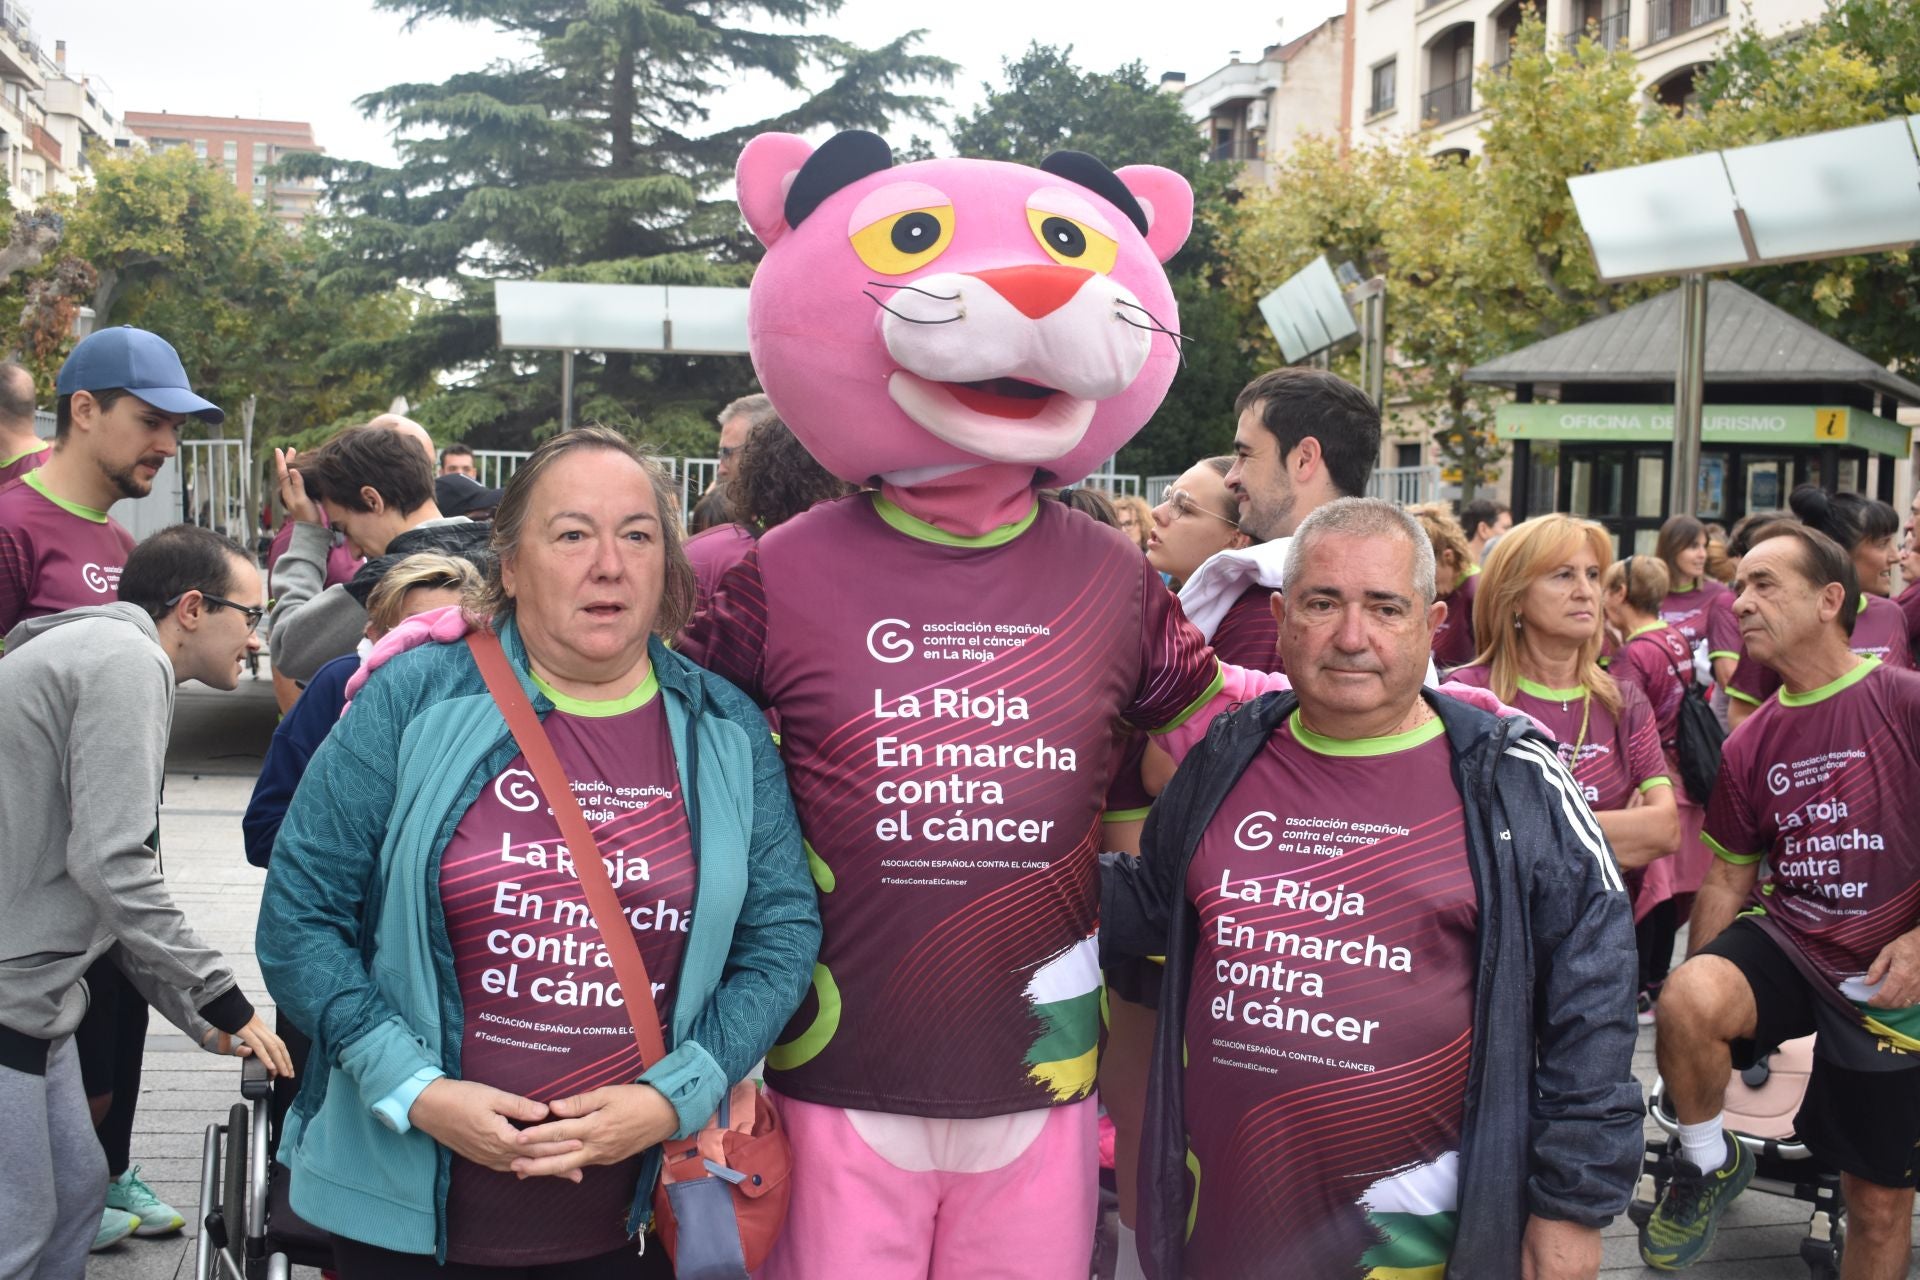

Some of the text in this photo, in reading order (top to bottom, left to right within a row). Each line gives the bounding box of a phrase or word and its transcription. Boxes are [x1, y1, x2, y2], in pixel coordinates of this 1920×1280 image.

[1560, 414, 1787, 432] OFICINA DE URISMO
[922, 621, 1050, 636] asociación española
[922, 635, 1026, 647] contra el cáncer
[923, 649, 995, 662] en La Rioja
[874, 688, 1029, 726] La Rioja
[876, 736, 1077, 772] En marcha
[1791, 750, 1866, 769] asociació española
[1793, 766, 1819, 778] contra
[1827, 760, 1847, 769] áncer
[569, 780, 673, 799] ciación española
[875, 773, 1004, 804] contra
[1805, 777, 1816, 785] La
[589, 795, 601, 806] el
[604, 796, 649, 809] cáncer
[1806, 797, 1848, 824] Roja
[583, 809, 615, 823] Rioja
[875, 810, 1054, 843] el cáncer
[1285, 816, 1409, 836] asociación española
[1282, 829, 1380, 845] contra el cáncer
[501, 832, 650, 888] La Rja
[1278, 842, 1344, 858] en La Rioja
[881, 858, 1050, 869] ASOCIACIÓN ESPAÑOLA CONTRA EL CÁNCER
[881, 877, 968, 886] #TodosContraElCáncer
[1219, 869, 1365, 921] La Rioja
[493, 881, 692, 933] En mch
[487, 928, 613, 967] contra
[1217, 915, 1412, 972] En marcha
[481, 963, 665, 1007] el cáncr
[1216, 959, 1324, 997] contra
[479, 1012, 532, 1029] ASOCIACIÓN
[534, 1023, 580, 1035] ESPAÑOLA
[582, 1027, 617, 1035] CONTRA
[1211, 989, 1379, 1044] el cáncer
[475, 1031, 571, 1053] #TodosContraElCáncer
[1212, 1038, 1375, 1072] ASOCIACIÓN ESPAÑOLA CONTRA EL CÁNCER
